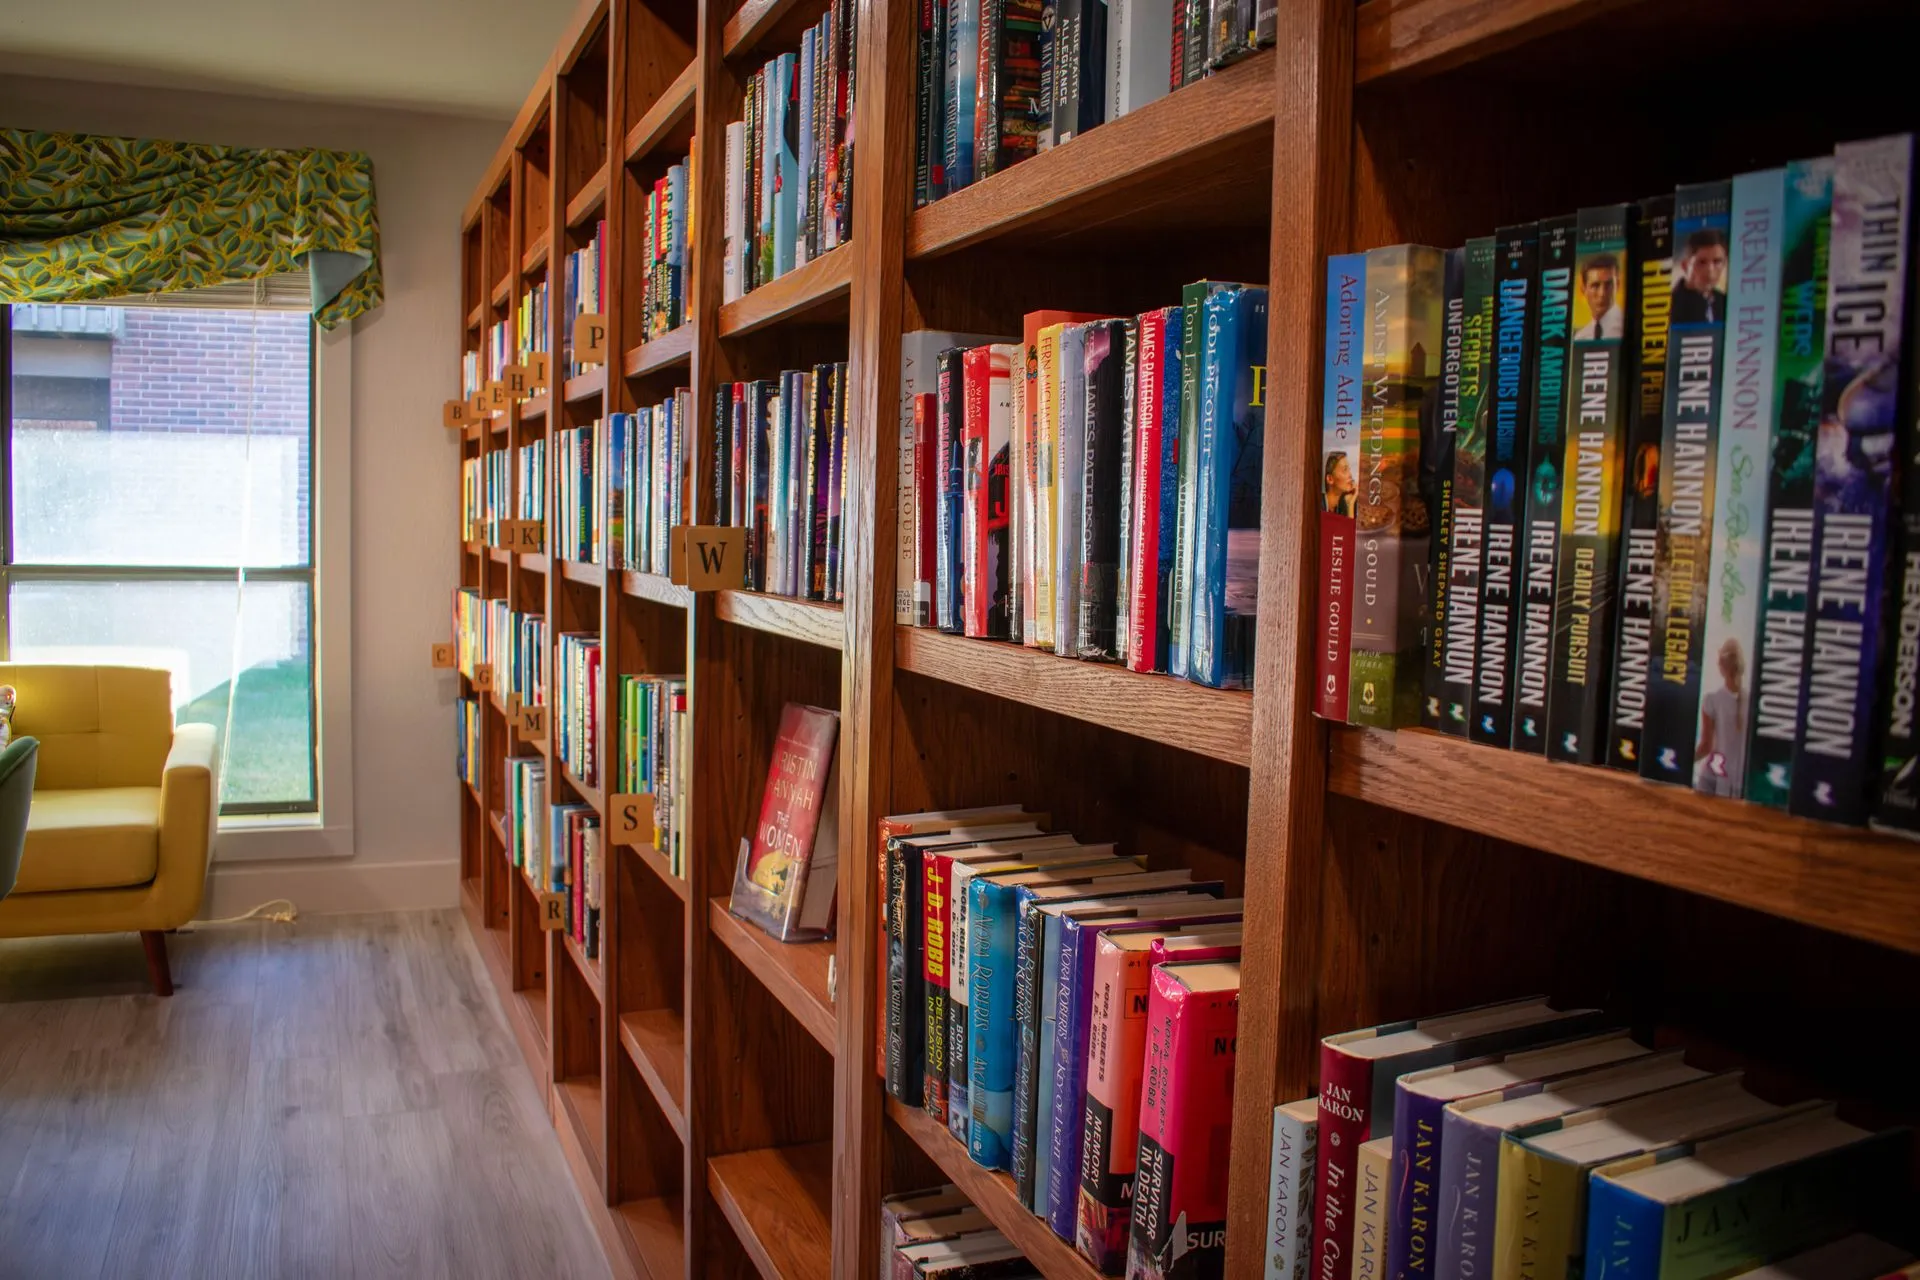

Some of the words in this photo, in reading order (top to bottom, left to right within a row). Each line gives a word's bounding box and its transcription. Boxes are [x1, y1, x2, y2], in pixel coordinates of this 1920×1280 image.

[1041, 40, 1053, 69] MAX
[1059, 18, 1070, 107] ALLEGIANCE
[1071, 57, 1079, 100] FAITH
[946, 97, 958, 170] FORGOTTEN
[808, 179, 817, 233] ROGUE
[1741, 206, 1769, 294] IRENE
[1861, 199, 1902, 274] THIN
[1185, 297, 1198, 345] Tom
[1206, 304, 1221, 353] JODI
[1255, 304, 1265, 313] #1
[1330, 273, 1358, 368] Adoring
[1539, 267, 1571, 340] DARK
[1641, 257, 1672, 364] HIDDEN
[1832, 281, 1888, 357] ICE
[590, 326, 605, 349] P
[905, 357, 915, 367] A
[1041, 336, 1052, 370] FERN
[1123, 328, 1137, 401] JAMES
[1141, 319, 1156, 362] JAMES
[1442, 297, 1463, 433] UNFORGOTTEN
[1459, 314, 1482, 398] SECRETS
[1496, 278, 1528, 397] DANGEROUS
[493, 387, 503, 403] E
[511, 373, 525, 392] H
[537, 362, 544, 381] I
[939, 371, 950, 404] IRIS
[1017, 366, 1025, 414] KAREN
[1183, 353, 1197, 402] Lake
[1580, 350, 1610, 424] IRENE
[1676, 335, 1713, 415] IRENE
[1731, 304, 1765, 431] HANNON
[452, 405, 462, 420] B
[1040, 374, 1051, 442] MICHAELS
[1086, 383, 1097, 443] JAMES
[1140, 363, 1155, 429] PATTERSON
[1203, 365, 1219, 457] PICOULT
[1334, 373, 1355, 440] Addie
[903, 378, 915, 476] PAINTED
[939, 412, 951, 492] JOHANSEN
[1141, 431, 1149, 466] MERRY
[1368, 372, 1389, 506] WEDDINGS
[1120, 406, 1135, 539] PATTERSON
[1573, 432, 1605, 537] HANNON
[1670, 423, 1708, 536] HANNON
[1728, 445, 1754, 495] Sea
[902, 484, 914, 560] HOUSE
[1084, 449, 1097, 561] PATTERSON
[1438, 479, 1451, 545] SHELLEY
[521, 527, 535, 545] K
[696, 541, 728, 575] W
[1452, 506, 1483, 578] IRENE
[1484, 523, 1514, 599] IRENE
[1525, 519, 1555, 596] IRENE
[1766, 508, 1814, 608] IRENE
[1816, 513, 1873, 613] IRENE
[1137, 557, 1145, 595] CROSS
[1330, 535, 1343, 598] LESLIE
[1364, 539, 1379, 607] GOULD
[1434, 551, 1447, 621] SHEPARD
[1572, 547, 1594, 610] DEADLY
[1623, 529, 1656, 610] IRENE
[1667, 544, 1695, 613] LETHAL
[1719, 561, 1746, 624] Lane
[436, 648, 446, 661] C
[1326, 601, 1341, 661] GOULD
[1431, 626, 1443, 668] GRAY
[1478, 603, 1509, 705] HANNON
[1519, 602, 1550, 708] HANNON
[1566, 612, 1591, 686] PURSUIT
[1662, 616, 1690, 685] LEGACY
[1890, 551, 1920, 738] HENDERSON
[478, 669, 489, 683] G
[1615, 617, 1650, 729] HANNON
[1756, 610, 1805, 741] HANNON
[1804, 619, 1864, 759] HANNON
[524, 712, 541, 732] M
[622, 804, 639, 832] S
[759, 820, 803, 857] WOMEN
[776, 810, 790, 828] THE
[890, 860, 903, 891] NORA
[926, 865, 944, 885] J.
[926, 890, 944, 912] D.
[546, 899, 560, 920] R
[890, 893, 904, 938] ROBERTS
[958, 885, 967, 924] NORA
[1026, 906, 1039, 953] NORA
[926, 916, 944, 977] ROBB
[973, 912, 994, 959] NORA
[1016, 919, 1028, 962] NORA
[1060, 943, 1073, 979] NORA
[927, 995, 935, 1010] IN
[949, 1007, 956, 1023] IN
[970, 961, 994, 1033] ROBERTS
[1022, 958, 1036, 1024] ROBERTS
[1056, 980, 1072, 1040] ROBERTS
[1102, 982, 1111, 1019] NORA
[926, 1011, 935, 1065] DEATH
[934, 995, 943, 1072] DELUSION
[955, 1023, 964, 1062] BORN
[1098, 1022, 1108, 1084] ROBERTS
[1162, 1016, 1173, 1060] NORA
[1055, 1062, 1067, 1093] KEY
[1055, 1095, 1065, 1114] OF
[1147, 1065, 1158, 1110] ROBB
[1158, 1065, 1169, 1137] ROBERTS
[1326, 1082, 1352, 1103] JAN
[1085, 1107, 1094, 1127] IN
[1318, 1093, 1365, 1123] KARON
[1052, 1117, 1064, 1161] LIGHT
[1081, 1128, 1093, 1180] DEATH
[1090, 1115, 1103, 1189] MEMORY
[1140, 1145, 1153, 1167] IN
[1278, 1127, 1292, 1169] JAN
[1414, 1119, 1434, 1172] JAN
[1134, 1173, 1151, 1228] DEATH
[1146, 1149, 1164, 1241] SURVIVOR
[1326, 1159, 1345, 1188] In
[1362, 1163, 1379, 1215] JAN
[1464, 1151, 1482, 1200] JAN
[1523, 1172, 1541, 1224] JAN
[1273, 1174, 1289, 1248] KARON
[1324, 1193, 1344, 1232] the
[1409, 1180, 1430, 1273] KARON
